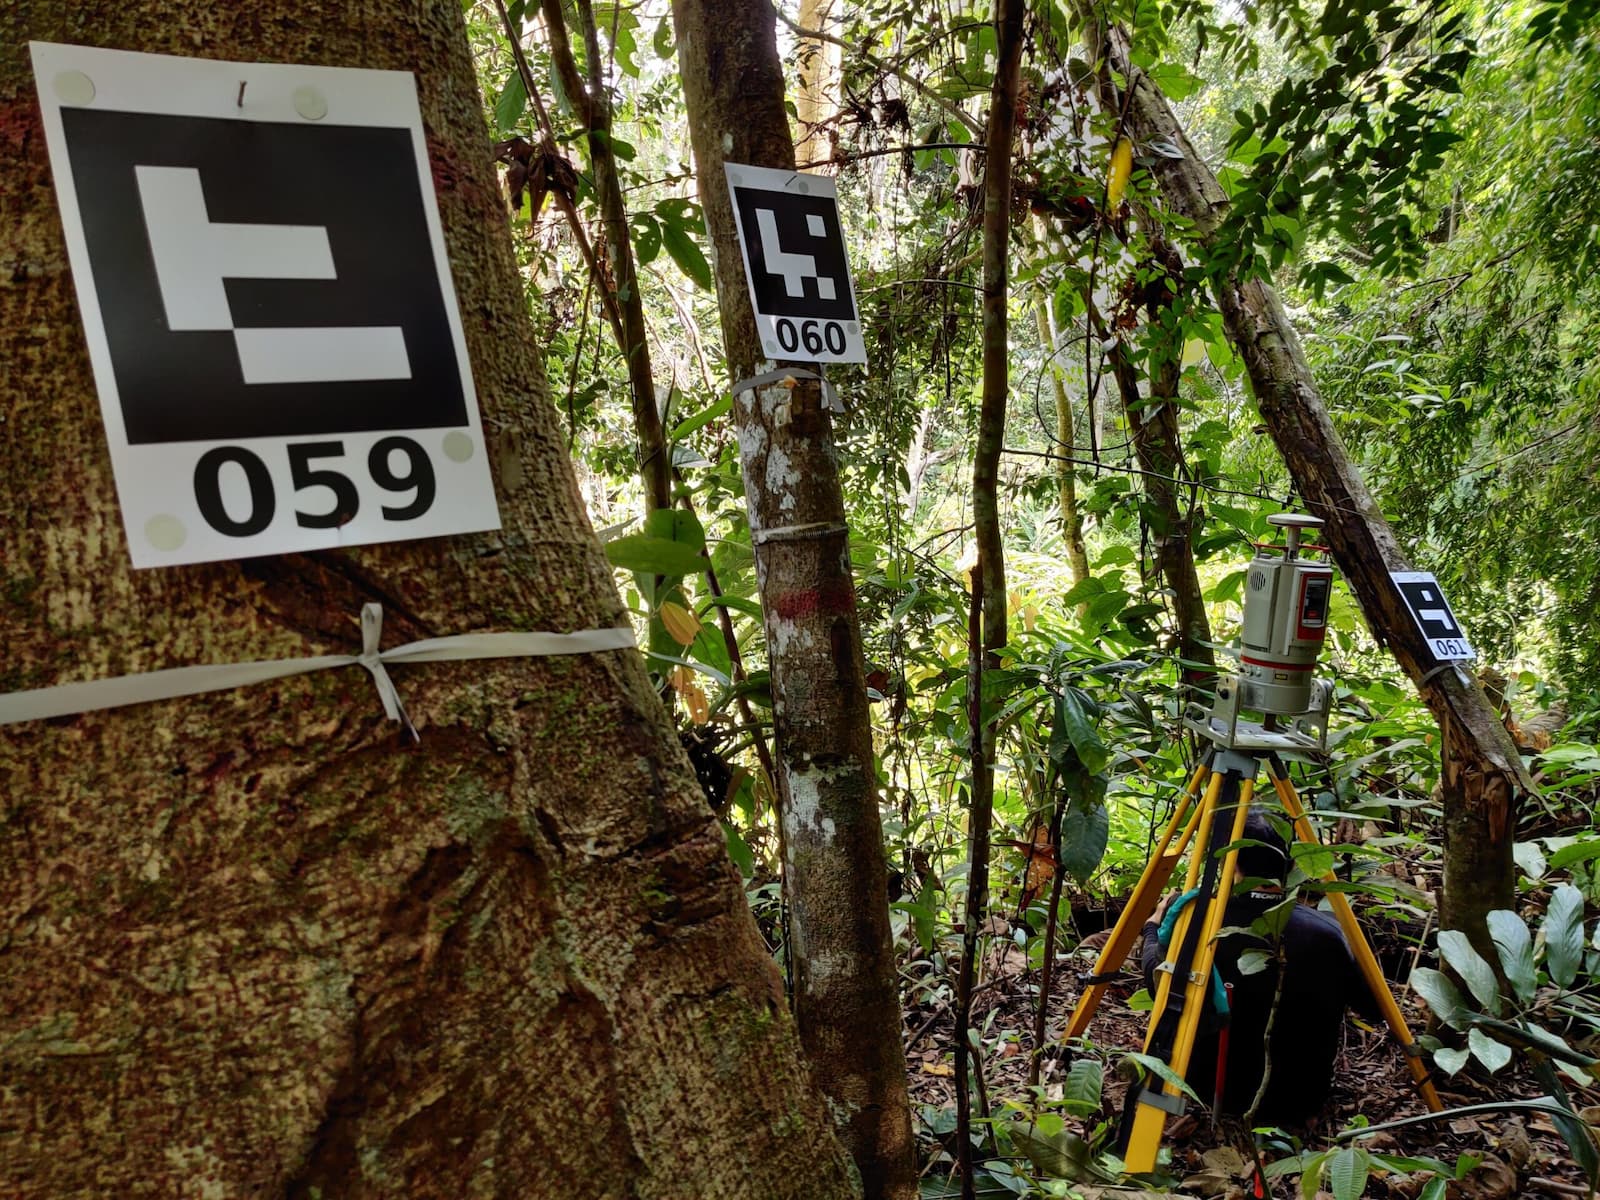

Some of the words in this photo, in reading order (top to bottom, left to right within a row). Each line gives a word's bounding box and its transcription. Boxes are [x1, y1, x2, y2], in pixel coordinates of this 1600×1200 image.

[776, 318, 847, 356] 060
[193, 435, 437, 537] 059
[1436, 640, 1467, 655] 061
